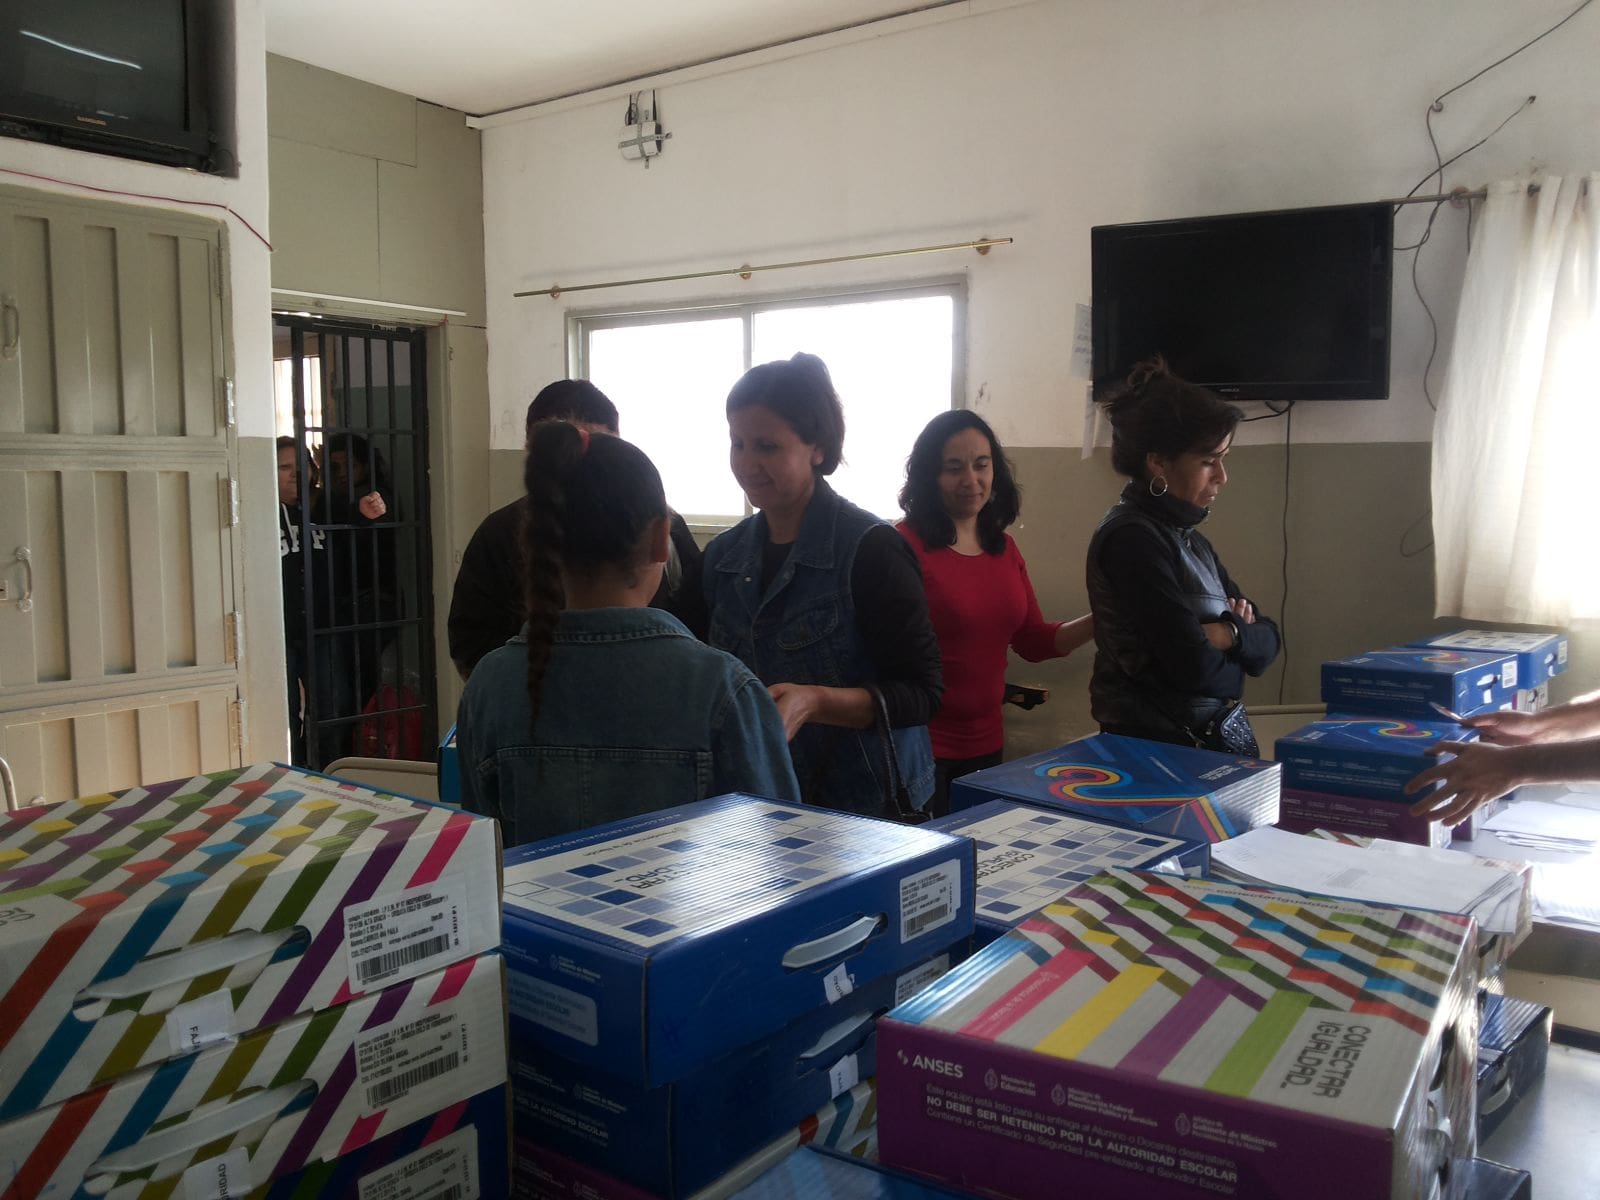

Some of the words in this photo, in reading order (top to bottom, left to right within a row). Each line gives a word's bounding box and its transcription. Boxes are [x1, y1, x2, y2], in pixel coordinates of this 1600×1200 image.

[912, 1054, 964, 1079] ANSES
[1000, 1082, 1037, 1097] Educación
[1313, 1025, 1372, 1099] CONECTAR
[926, 1083, 944, 1097] Este
[946, 1088, 974, 1105] equipo
[975, 1094, 993, 1107] está
[1012, 1106, 1033, 1120] para
[1035, 1111, 1045, 1121] su
[1047, 1113, 1080, 1131] entrega
[1091, 1124, 1126, 1142] Alumno
[1137, 1136, 1177, 1154] Docente
[926, 1095, 942, 1108] NO
[945, 1100, 973, 1116] DEBE
[976, 1108, 998, 1121] SER
[1001, 1115, 1056, 1137] RETENIDO
[1060, 1129, 1084, 1144] POR
[1088, 1135, 1103, 1148] LA
[1107, 1141, 1175, 1167] AUTORIDAD
[1180, 1160, 1238, 1184] ESCOLAR
[926, 1106, 962, 1125] Contiene
[964, 1118, 976, 1128] un
[977, 1118, 1022, 1140] Certificado
[1023, 1130, 1036, 1143] de
[1037, 1136, 1083, 1157] Seguridad
[1146, 1163, 1155, 1175] al
[1157, 1165, 1196, 1187] Servidor
[1192, 1121, 1228, 1138] Gabinete
[1229, 1130, 1240, 1140] de
[1241, 1132, 1278, 1149] Ministros
